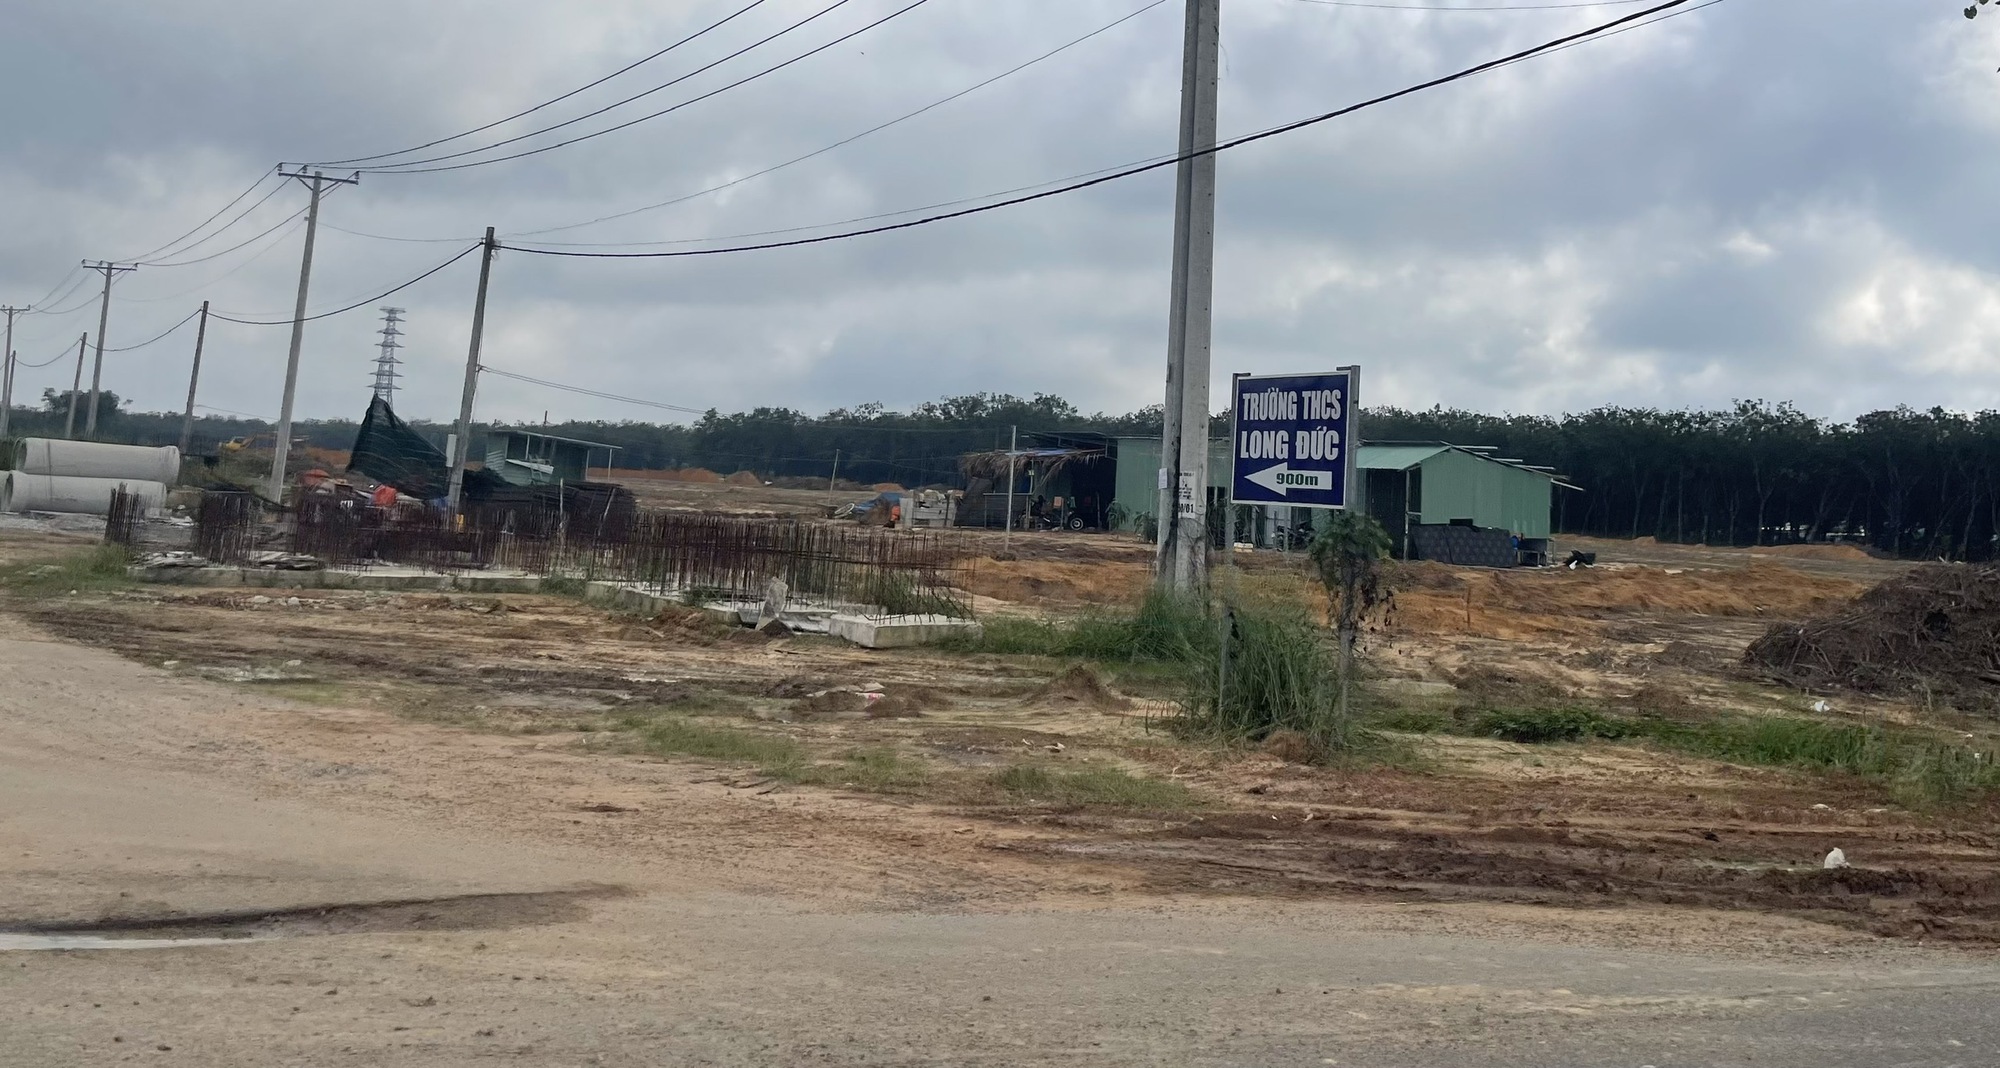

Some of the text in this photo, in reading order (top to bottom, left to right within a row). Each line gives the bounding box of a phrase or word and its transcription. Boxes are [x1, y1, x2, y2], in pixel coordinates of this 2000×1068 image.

[1243, 387, 1341, 420] TRƯỜNG THCS
[1240, 426, 1339, 460] LONG ĐỨC
[1276, 473, 1318, 486] 900m
